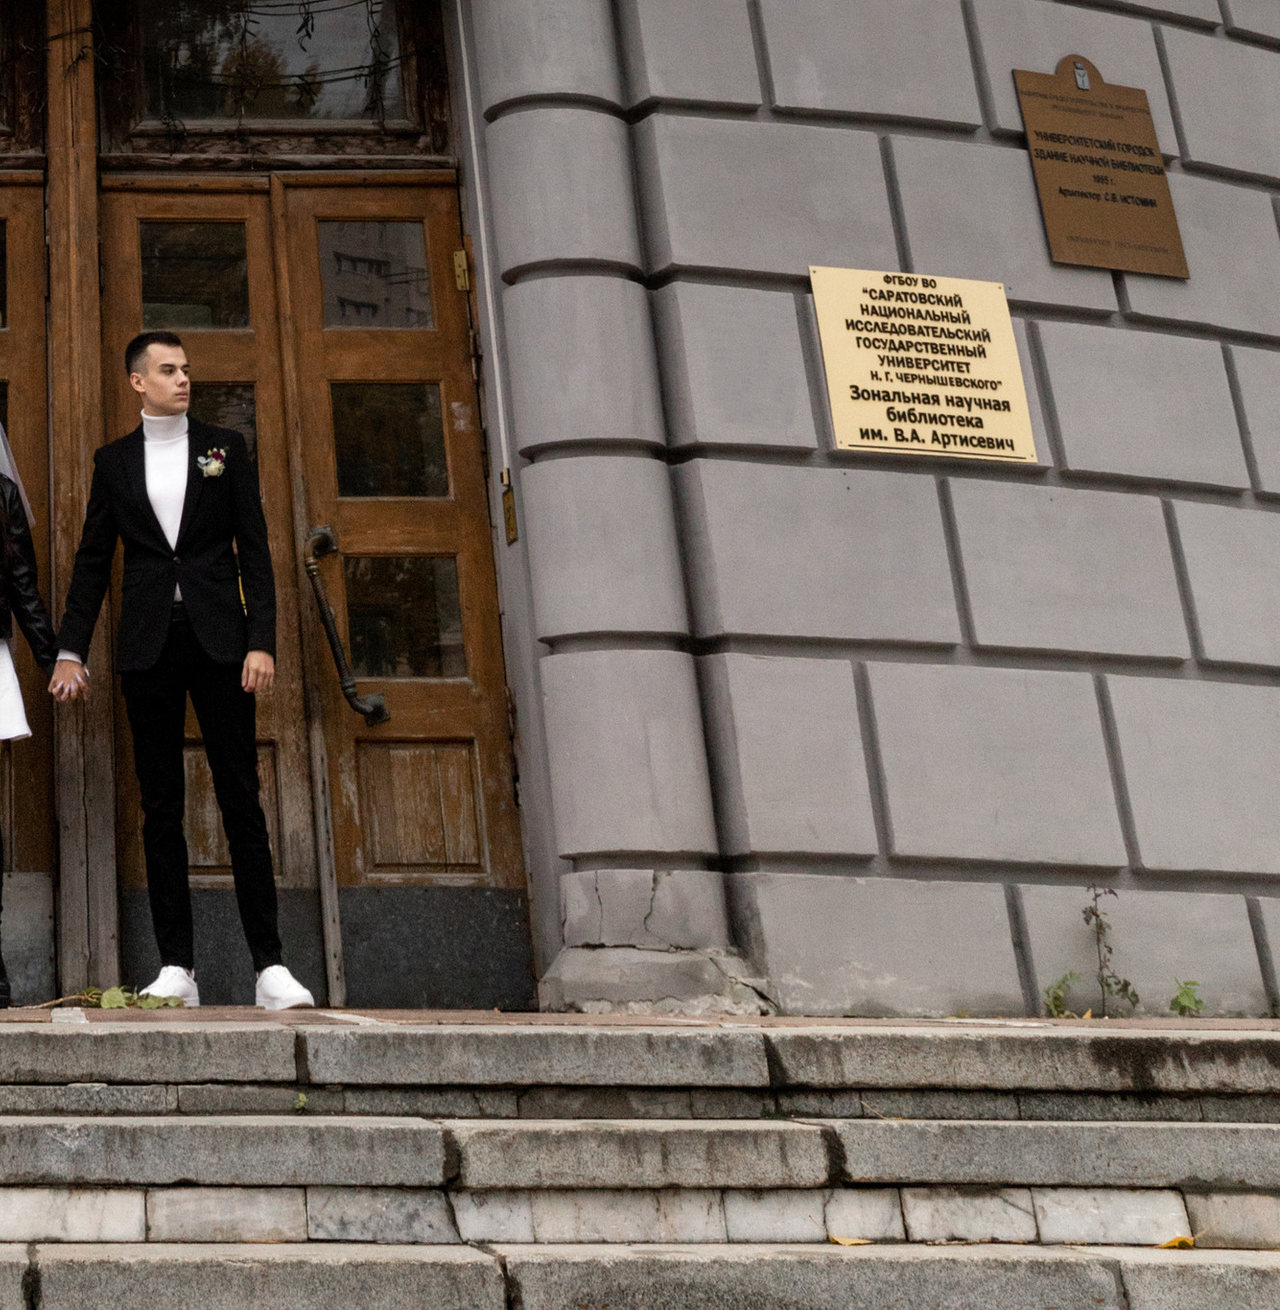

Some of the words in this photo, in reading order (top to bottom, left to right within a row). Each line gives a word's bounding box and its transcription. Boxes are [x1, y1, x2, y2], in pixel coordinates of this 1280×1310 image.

[883, 274, 919, 287] ФГБОУ
[922, 278, 937, 289] ВО
[860, 304, 971, 325] НАЦИОНАЛЬНЫЙ
[845, 319, 991, 343] ИССЛЕДОВАТЕЛЬСКИЙ
[856, 336, 986, 359] ГОСУДАРСТВЕННЫЙ
[877, 355, 971, 374] УНИВЕРСИТЕТ
[850, 385, 941, 406] Зональная
[945, 395, 1011, 413] научная
[887, 407, 983, 429] библиотека
[859, 427, 888, 442] им.
[930, 430, 1015, 452] Артисевич
